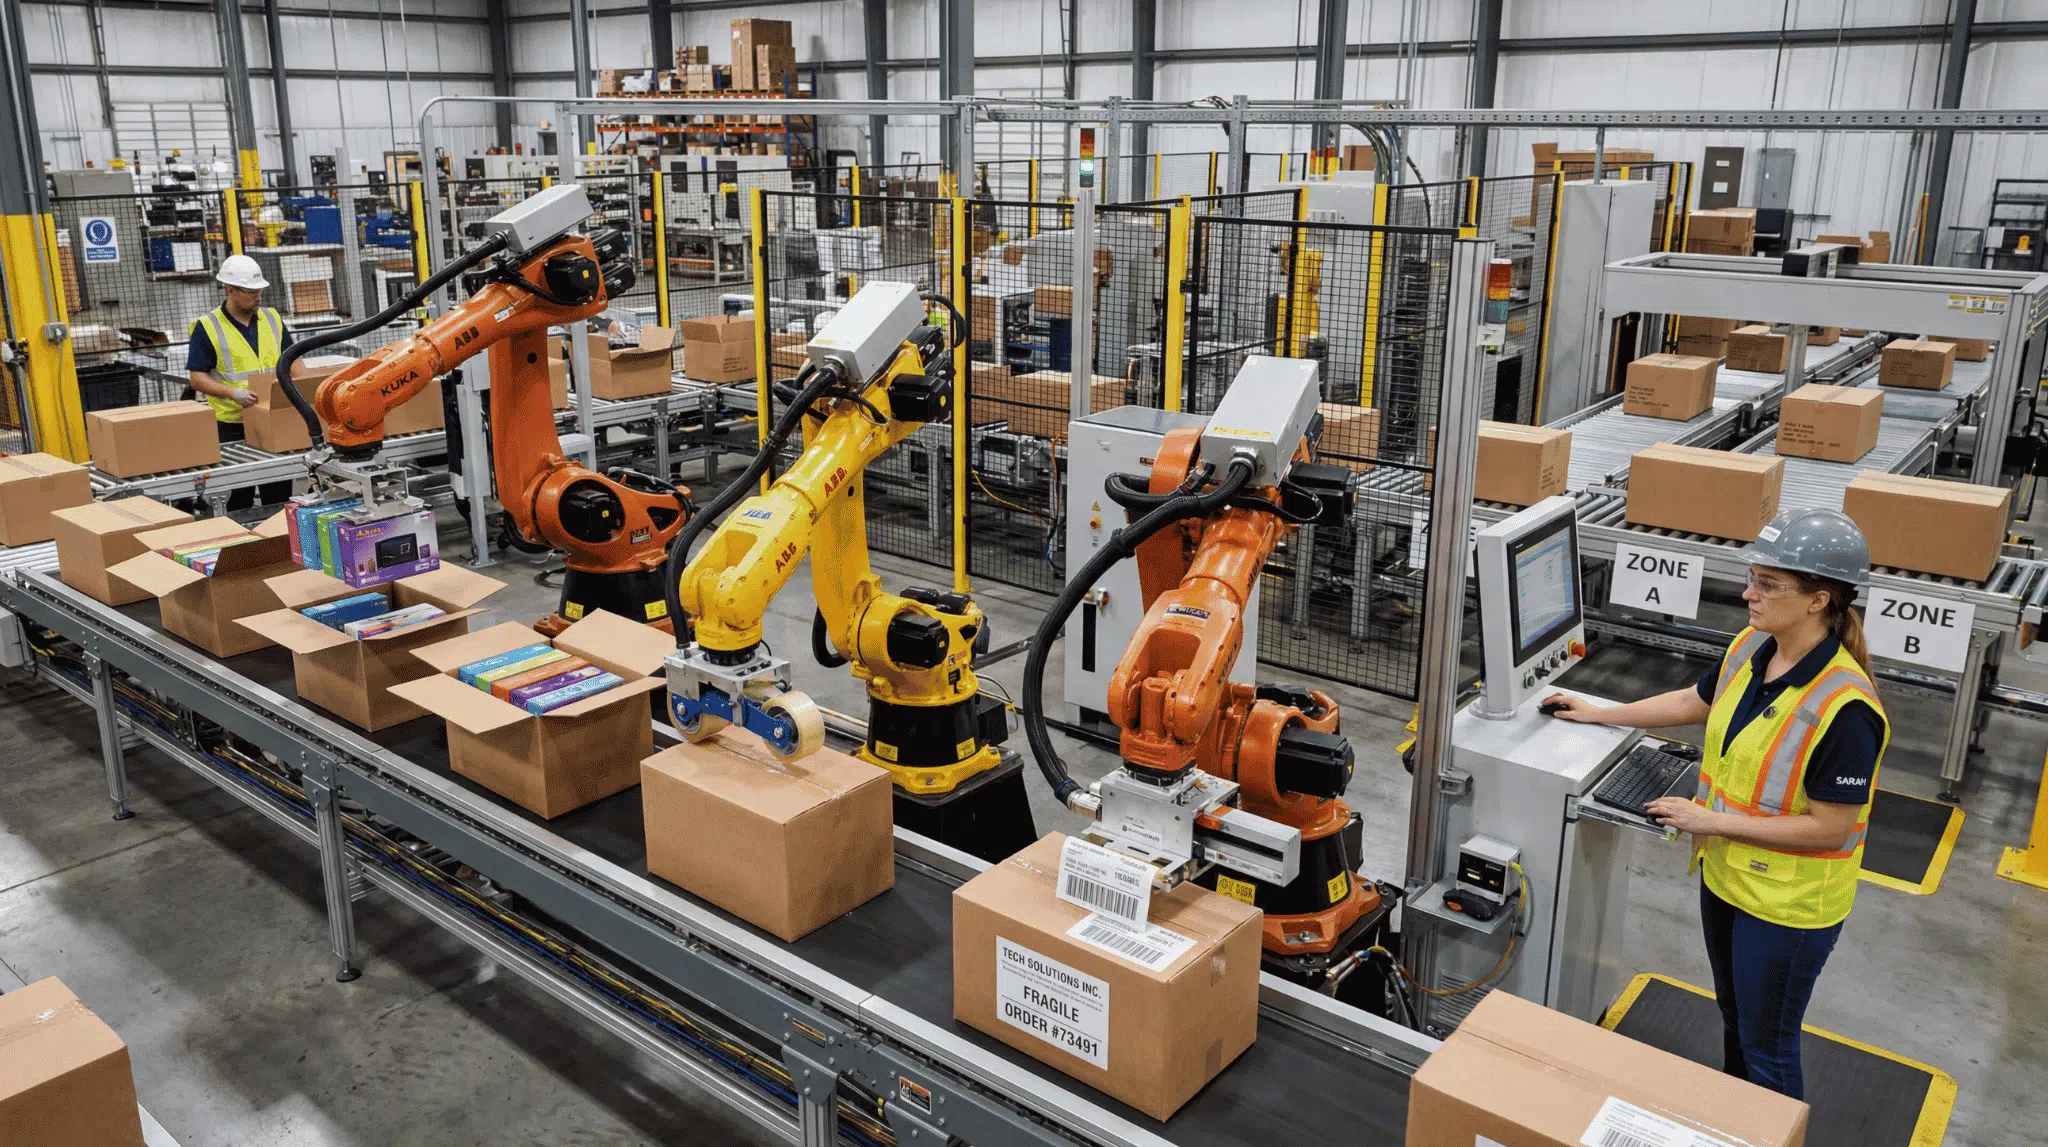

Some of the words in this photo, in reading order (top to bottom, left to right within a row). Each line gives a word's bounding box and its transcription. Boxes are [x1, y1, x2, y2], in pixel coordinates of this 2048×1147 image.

[453, 326, 480, 350] ABB
[380, 370, 419, 397] KUKA
[1626, 552, 1689, 580] ZONE
[1644, 586, 1661, 605] A
[1880, 598, 1957, 628] ZONE
[1903, 636, 1921, 655] B
[1835, 776, 1867, 786] SARAH
[1002, 946, 1026, 966] TECH
[1027, 957, 1080, 989] SOLUTIONS
[1082, 981, 1102, 999] INC.
[1023, 985, 1080, 1024] FRAGILE
[1005, 1002, 1048, 1034] ORDER
[1051, 1024, 1098, 1058] #73491
